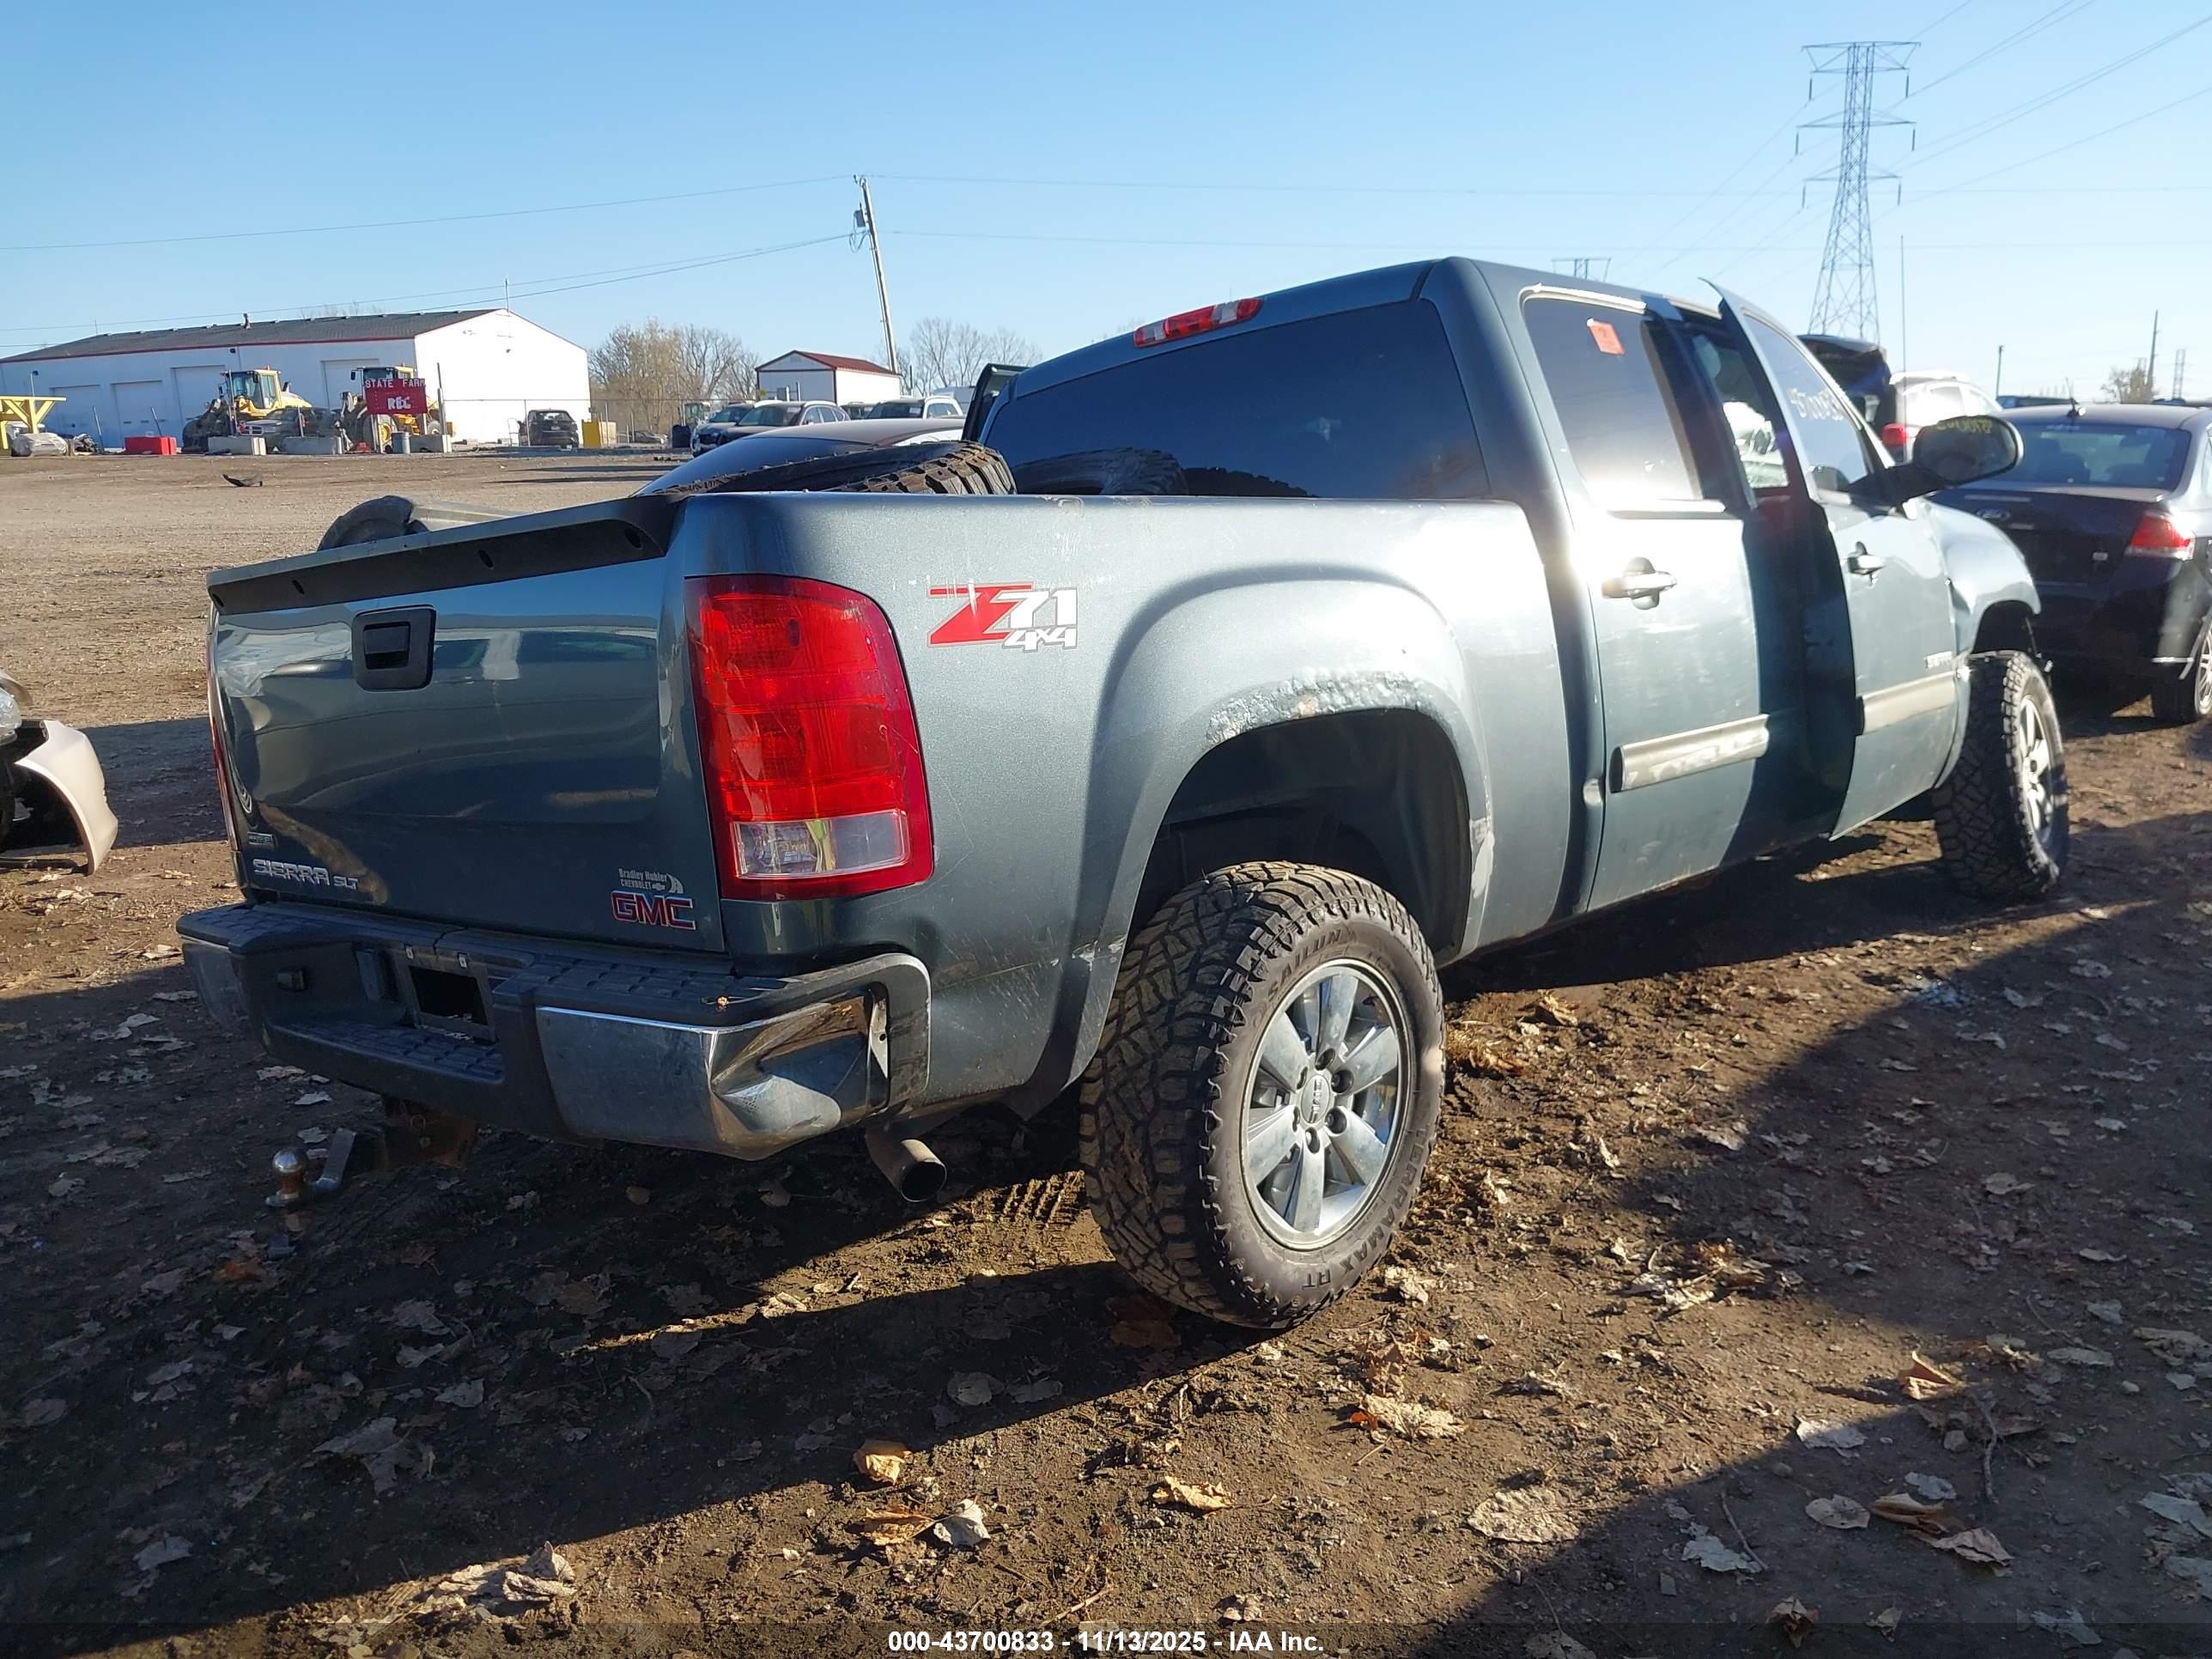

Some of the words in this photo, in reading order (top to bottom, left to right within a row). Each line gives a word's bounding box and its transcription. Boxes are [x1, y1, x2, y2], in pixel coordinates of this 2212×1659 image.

[365, 379, 394, 388] STATE
[402, 378, 426, 387] FARM
[927, 580, 1079, 649] Z71
[252, 859, 331, 886] SIERRA
[333, 876, 359, 890] SLT
[618, 867, 644, 881] Bradley
[620, 878, 653, 890] CHEVROLET
[611, 890, 696, 931] GMC
[1267, 928, 1341, 1003] SAILUN
[1339, 1127, 1428, 1273] TERRAMAX
